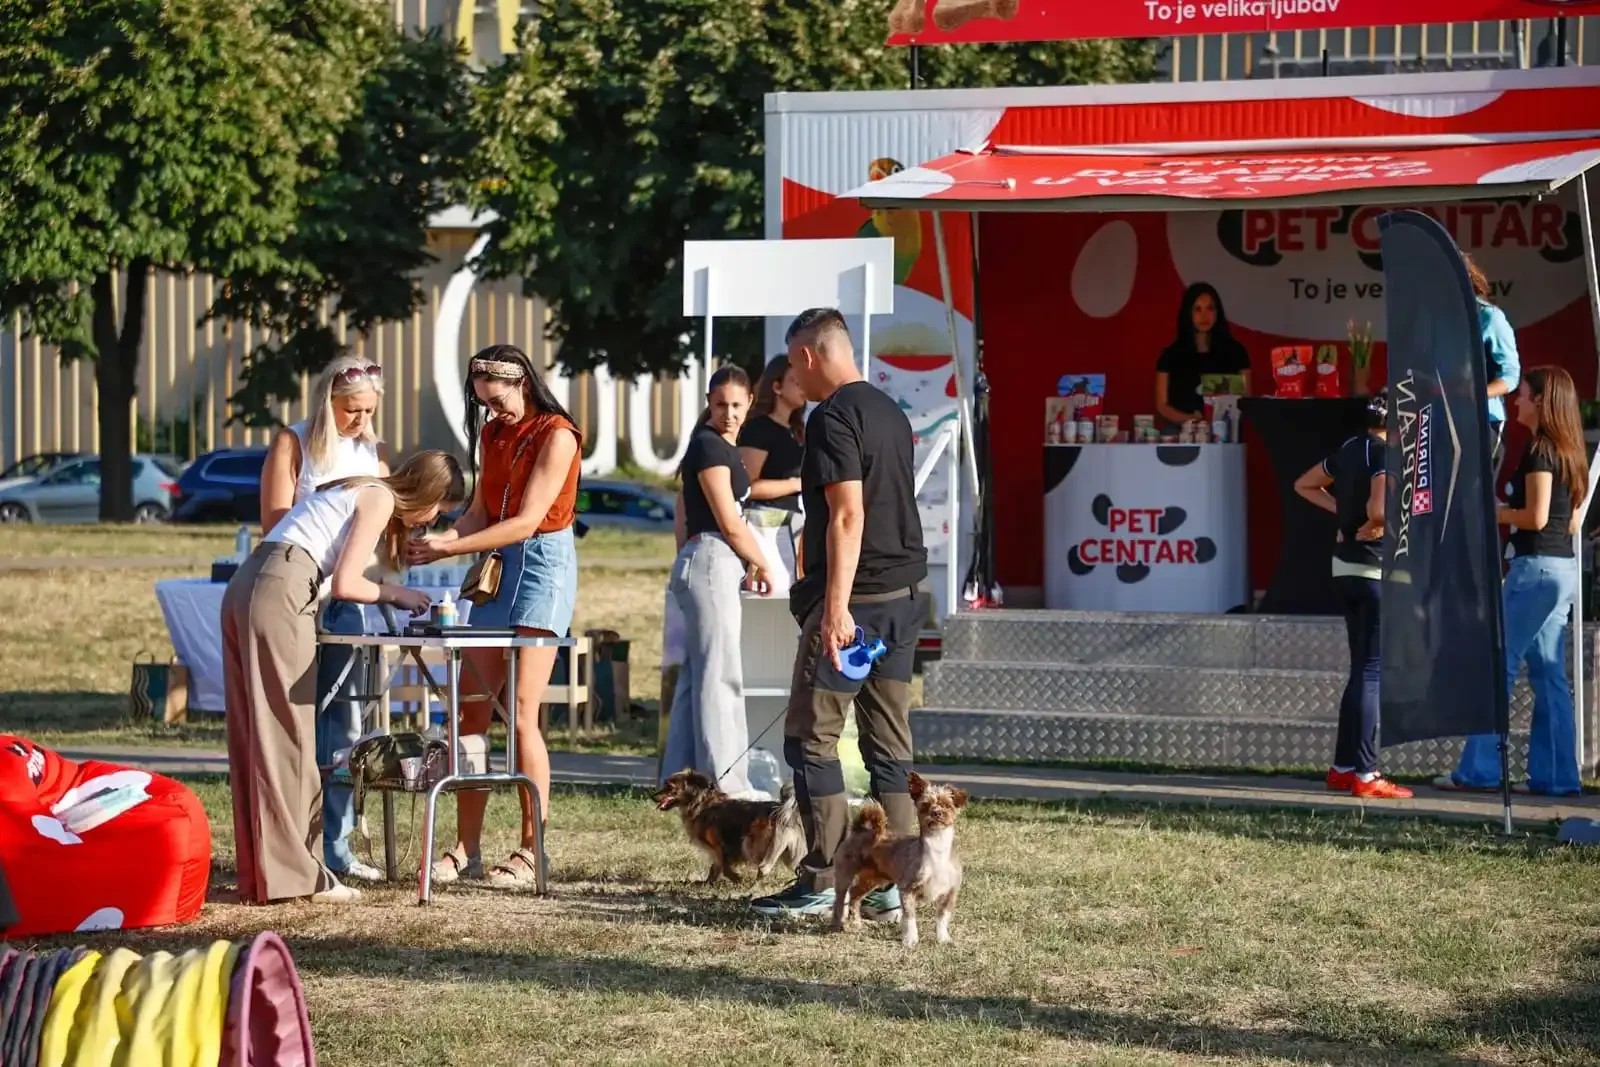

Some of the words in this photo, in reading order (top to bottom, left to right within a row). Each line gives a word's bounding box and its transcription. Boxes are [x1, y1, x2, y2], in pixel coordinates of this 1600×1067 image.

[1144, 2, 1171, 20] To
[1176, 3, 1197, 24] je
[1202, 0, 1264, 19] velika
[1270, 0, 1339, 19] ljubav
[1243, 205, 1341, 251] PET
[1289, 278, 1318, 299] To
[1325, 278, 1349, 303] je
[1109, 508, 1164, 534] PET
[1079, 538, 1196, 564] CENTAR
